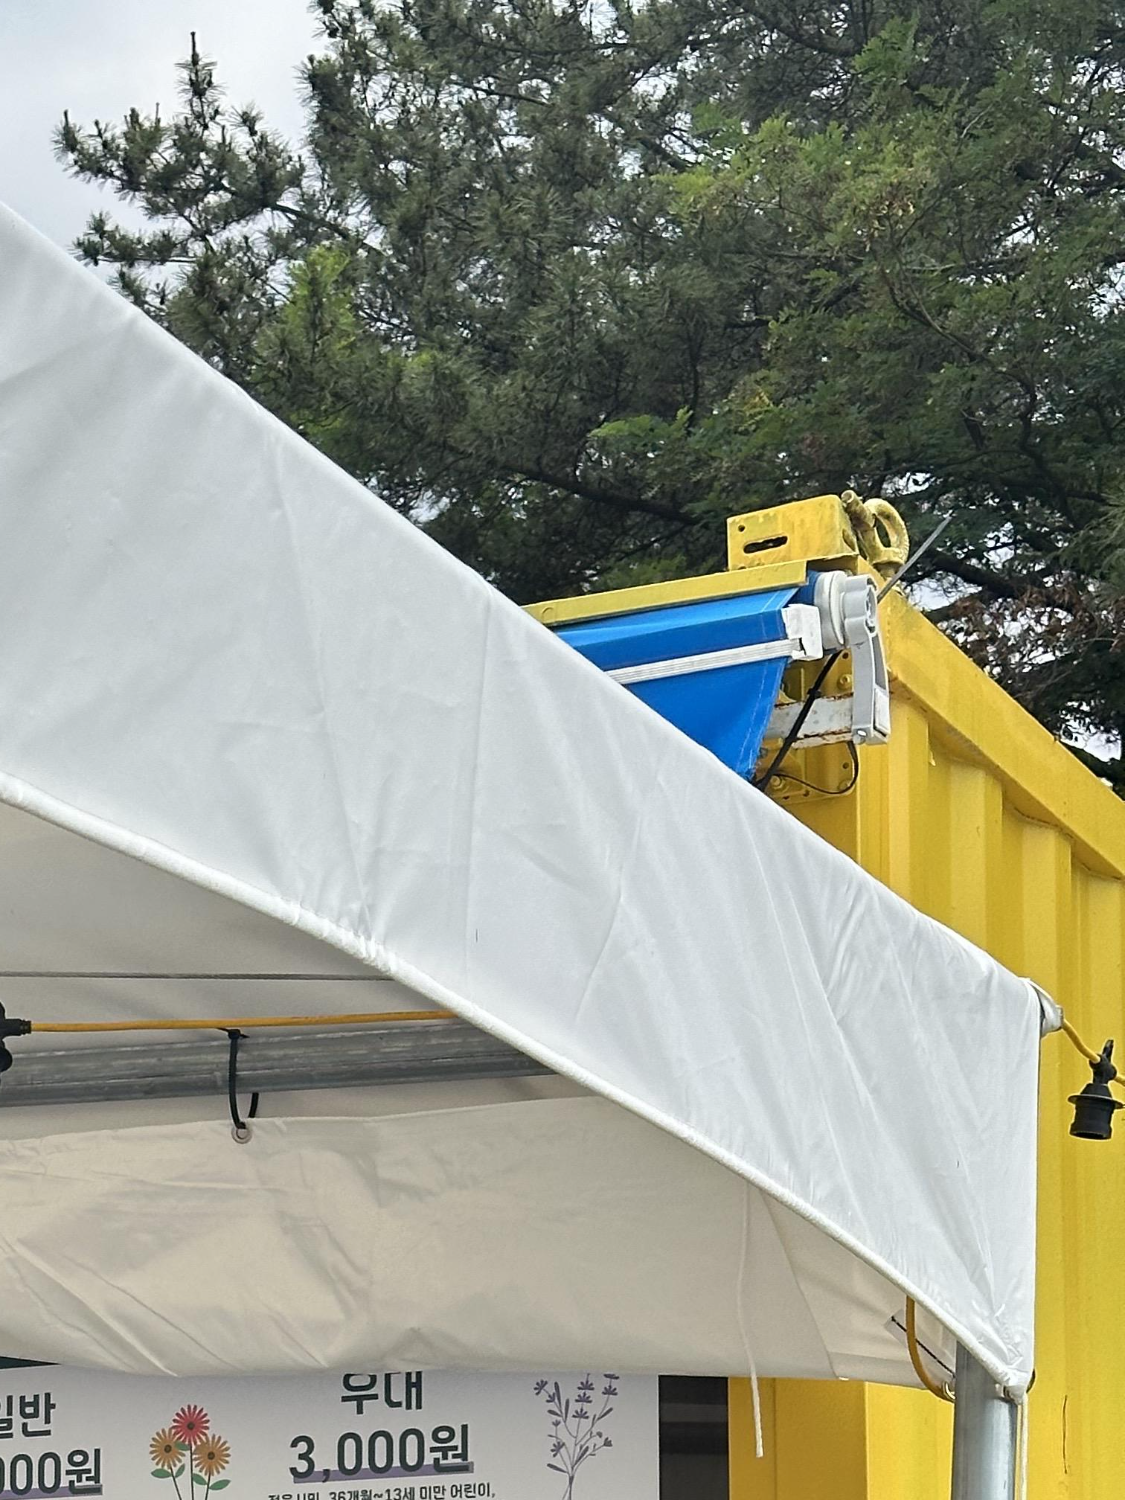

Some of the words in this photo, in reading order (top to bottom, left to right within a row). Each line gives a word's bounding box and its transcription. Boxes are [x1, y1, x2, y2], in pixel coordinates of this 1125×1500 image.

[341, 1371, 423, 1415] 우대
[289, 1424, 469, 1483] 3,000원
[419, 1486, 446, 1500] 미만
[450, 1482, 496, 1500] 어린이,
